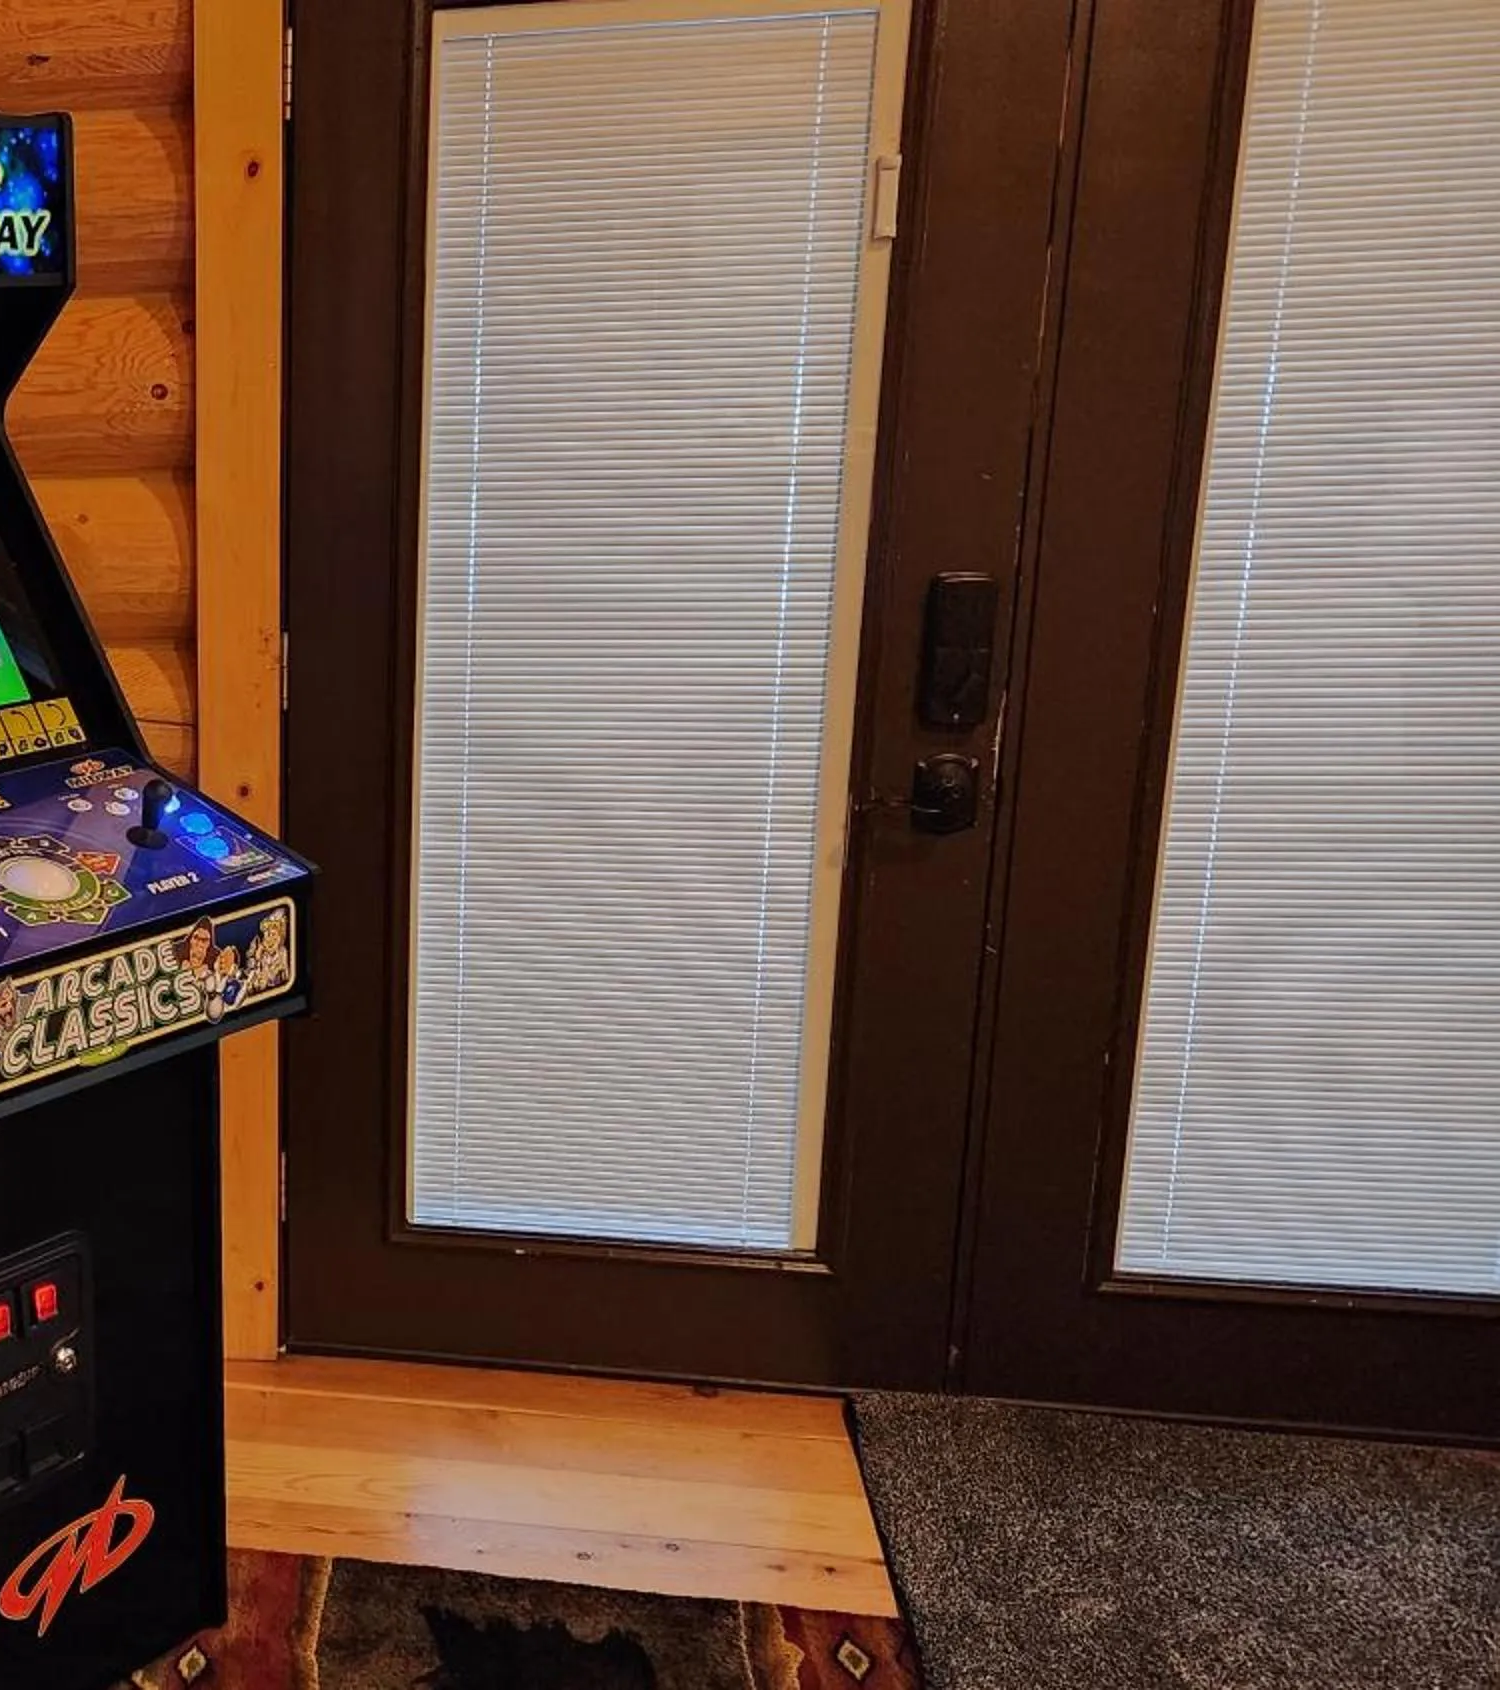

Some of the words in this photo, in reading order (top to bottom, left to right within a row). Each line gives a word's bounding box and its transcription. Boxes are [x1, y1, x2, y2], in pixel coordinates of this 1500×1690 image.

[146, 875, 192, 896] PLAYER
[186, 871, 201, 884] 2
[25, 940, 181, 1018] ARCADE
[2, 968, 202, 1079] CLASSICS
